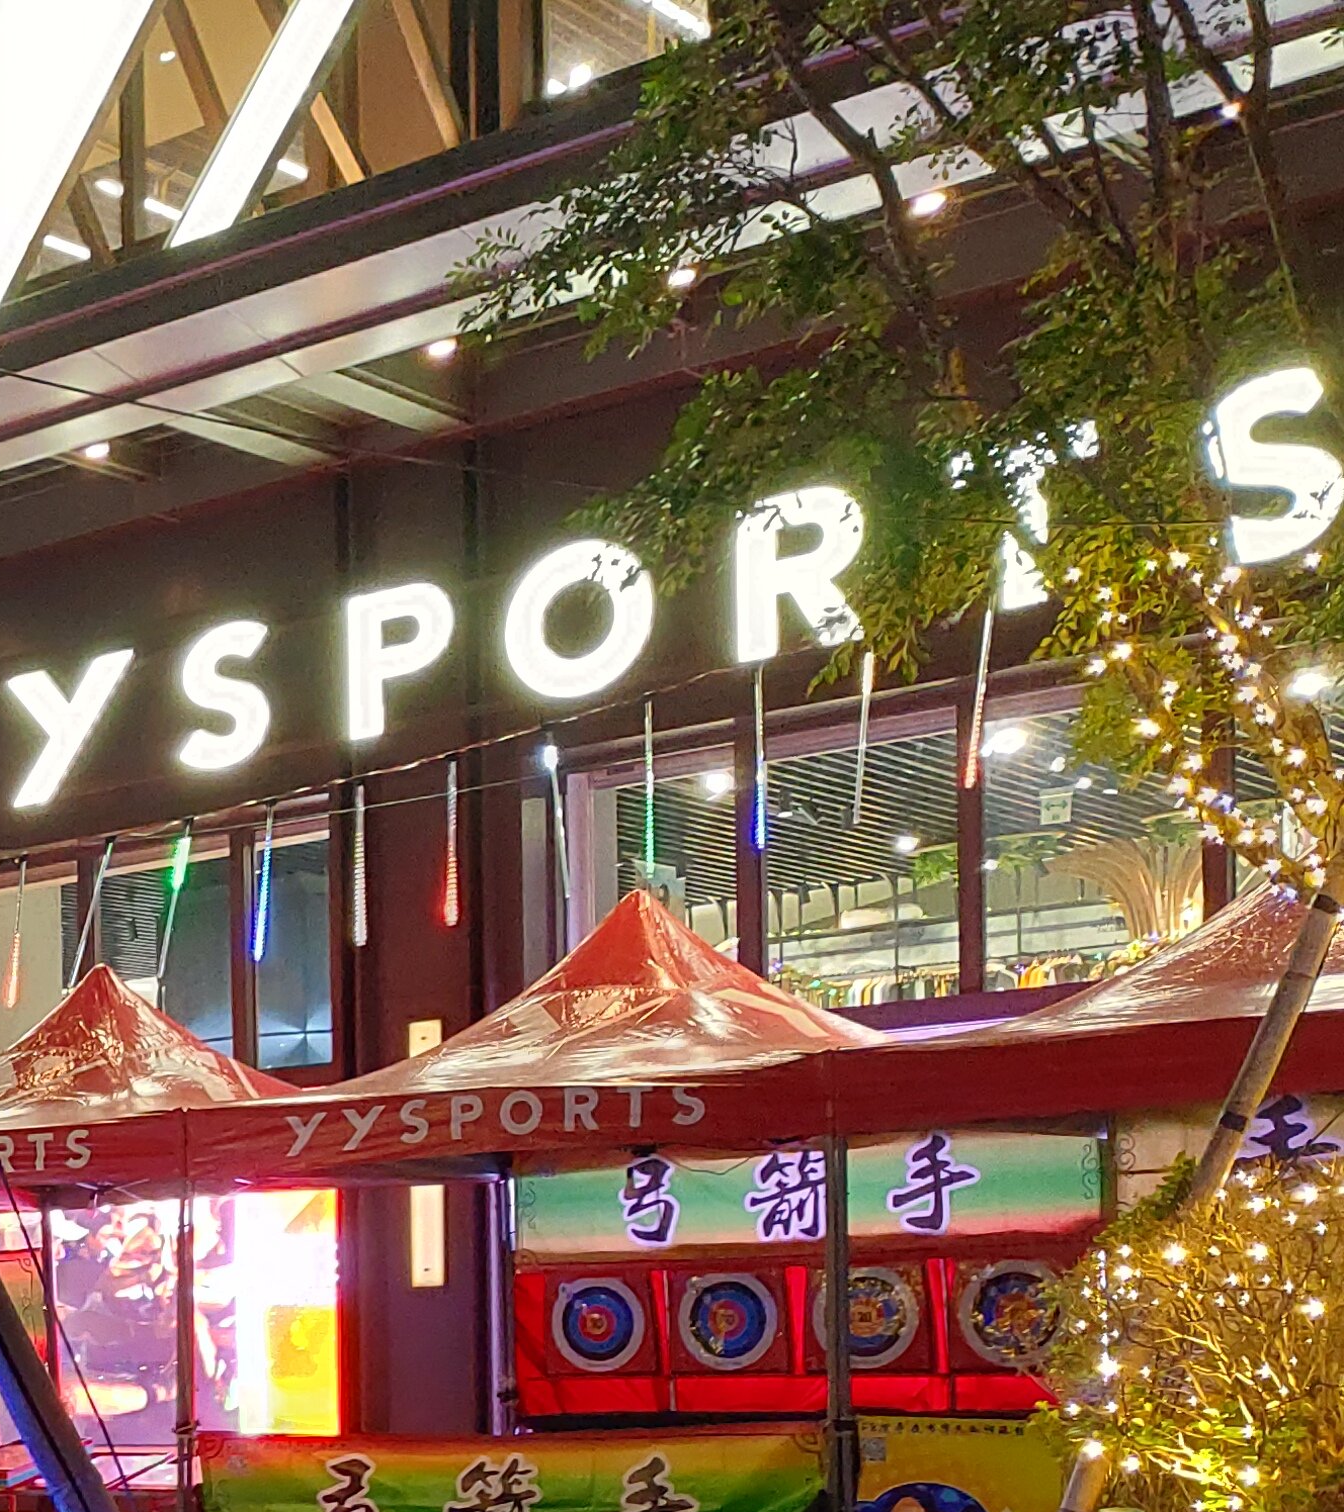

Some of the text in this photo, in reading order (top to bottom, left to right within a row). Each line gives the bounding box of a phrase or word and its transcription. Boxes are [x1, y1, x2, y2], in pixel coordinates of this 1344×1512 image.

[285, 1086, 707, 1157] YYSPORTS
[622, 1132, 976, 1246] 弓箭手
